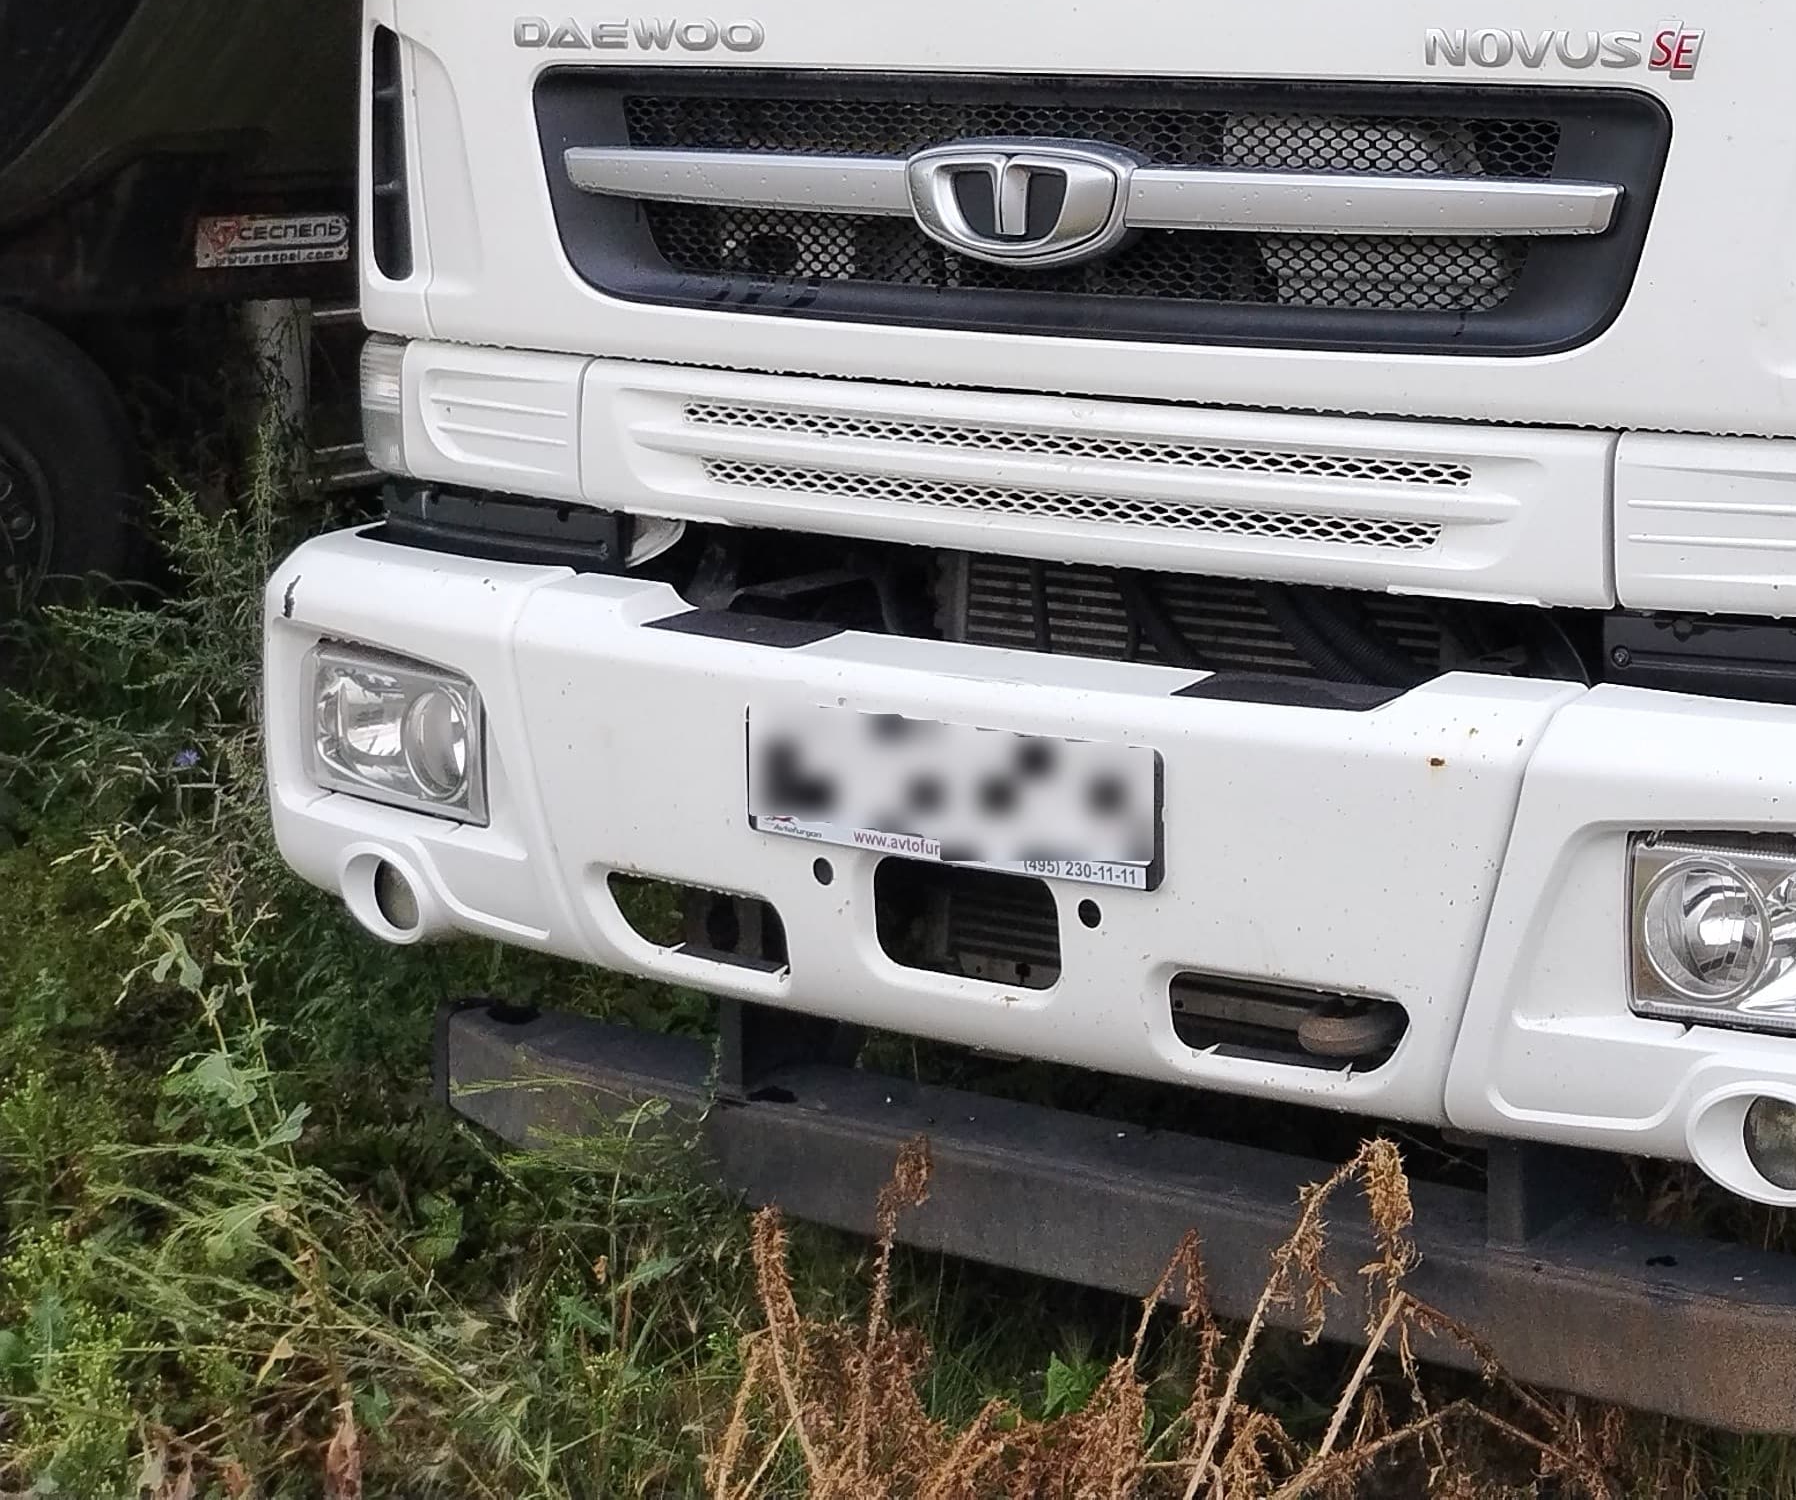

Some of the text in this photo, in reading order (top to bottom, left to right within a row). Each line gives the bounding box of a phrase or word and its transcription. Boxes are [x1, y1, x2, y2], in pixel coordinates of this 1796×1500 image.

[514, 16, 765, 52] DAEWOO
[1424, 28, 1702, 70] NOVUS SE
[239, 221, 343, 241] СЕСПЕЛЬ
[773, 823, 823, 839] Avtofurgon
[1064, 860, 1137, 885] 230-11-11
